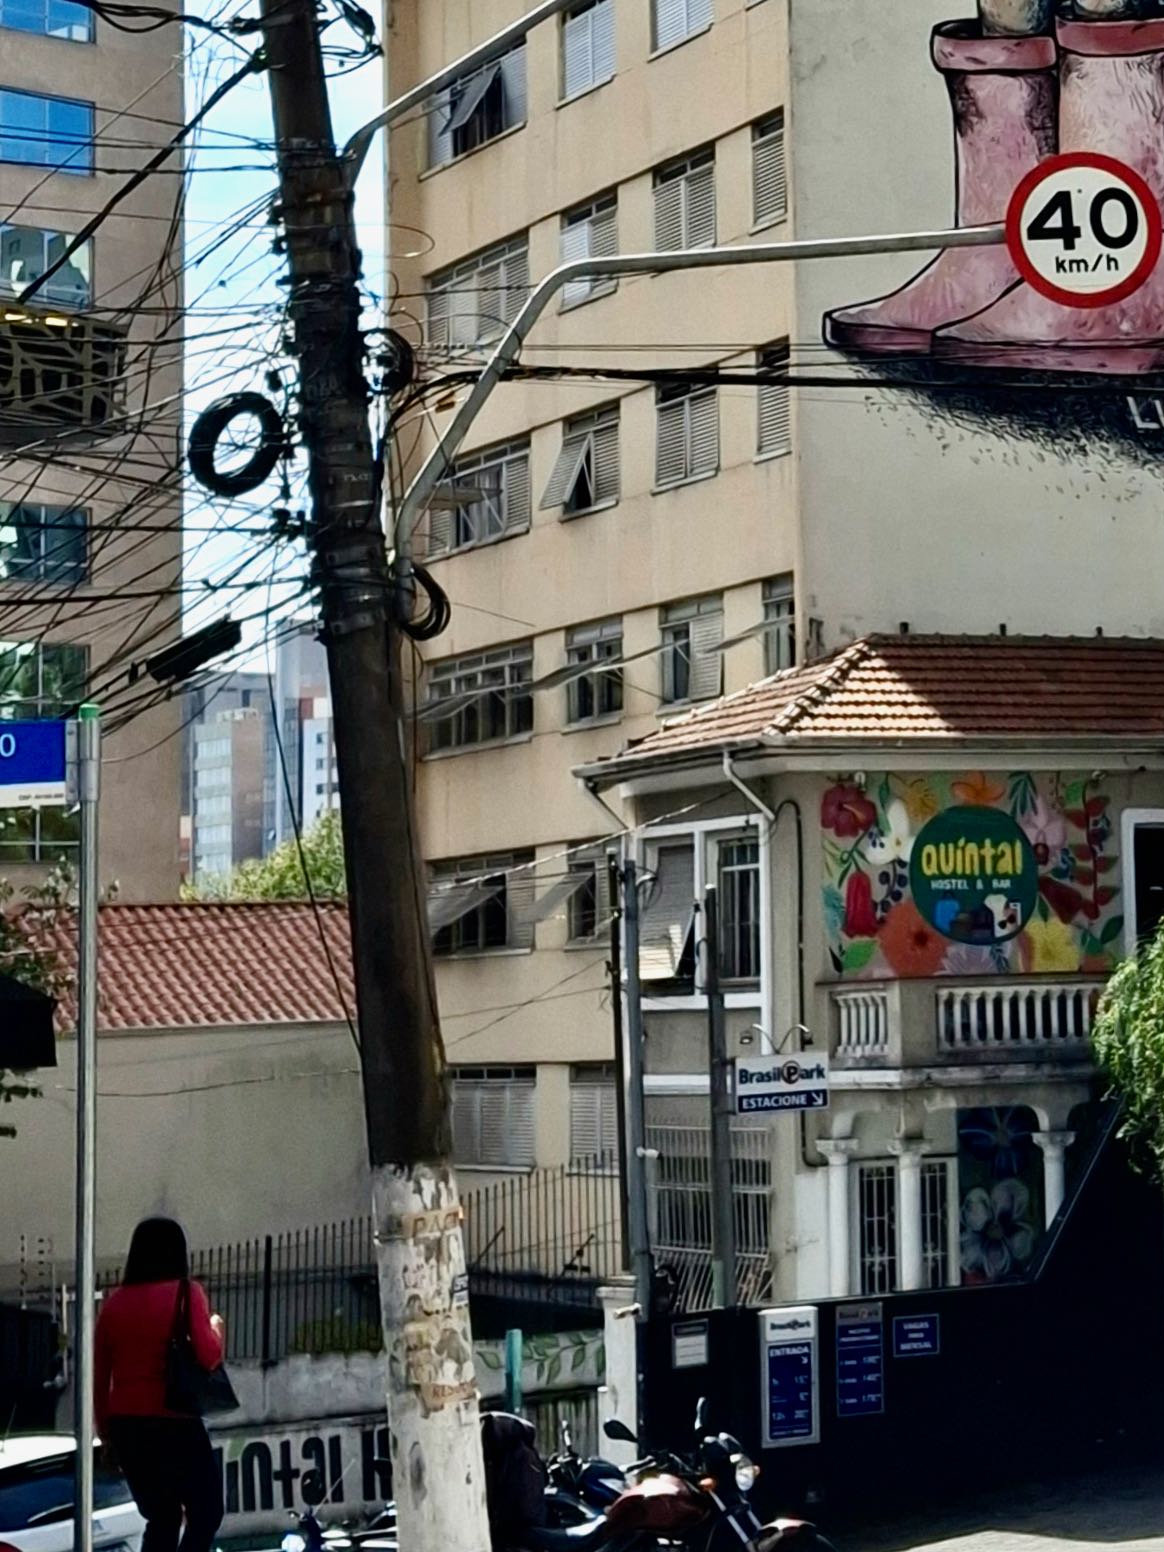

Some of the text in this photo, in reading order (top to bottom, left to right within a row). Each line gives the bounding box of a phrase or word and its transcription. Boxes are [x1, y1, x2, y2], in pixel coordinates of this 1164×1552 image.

[1027, 187, 1138, 250] 40
[1055, 253, 1119, 273] km/h
[931, 878, 968, 889] HOSTEL
[992, 878, 1011, 889] BAR
[742, 1093, 808, 1110] ESTACIONE
[769, 1346, 810, 1357] ENTRADA
